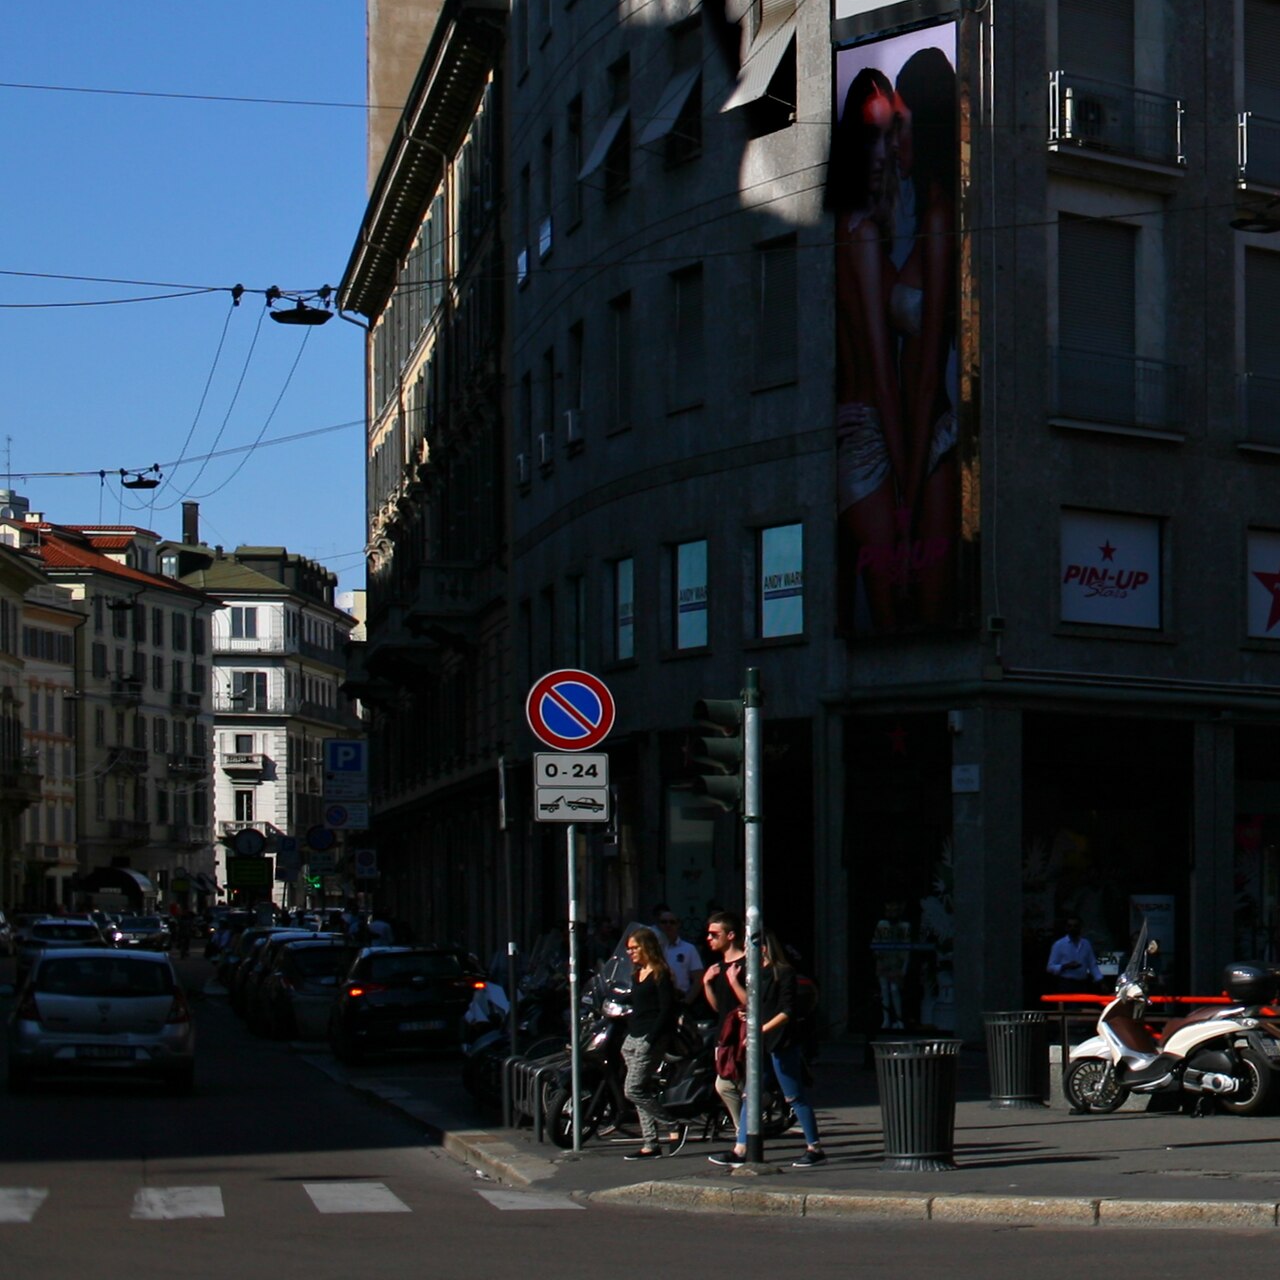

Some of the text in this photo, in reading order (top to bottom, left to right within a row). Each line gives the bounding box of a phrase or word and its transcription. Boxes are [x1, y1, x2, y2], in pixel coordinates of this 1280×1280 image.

[1063, 564, 1149, 591] PIN-UP
[337, 746, 355, 768] P
[572, 763, 598, 778] 24
